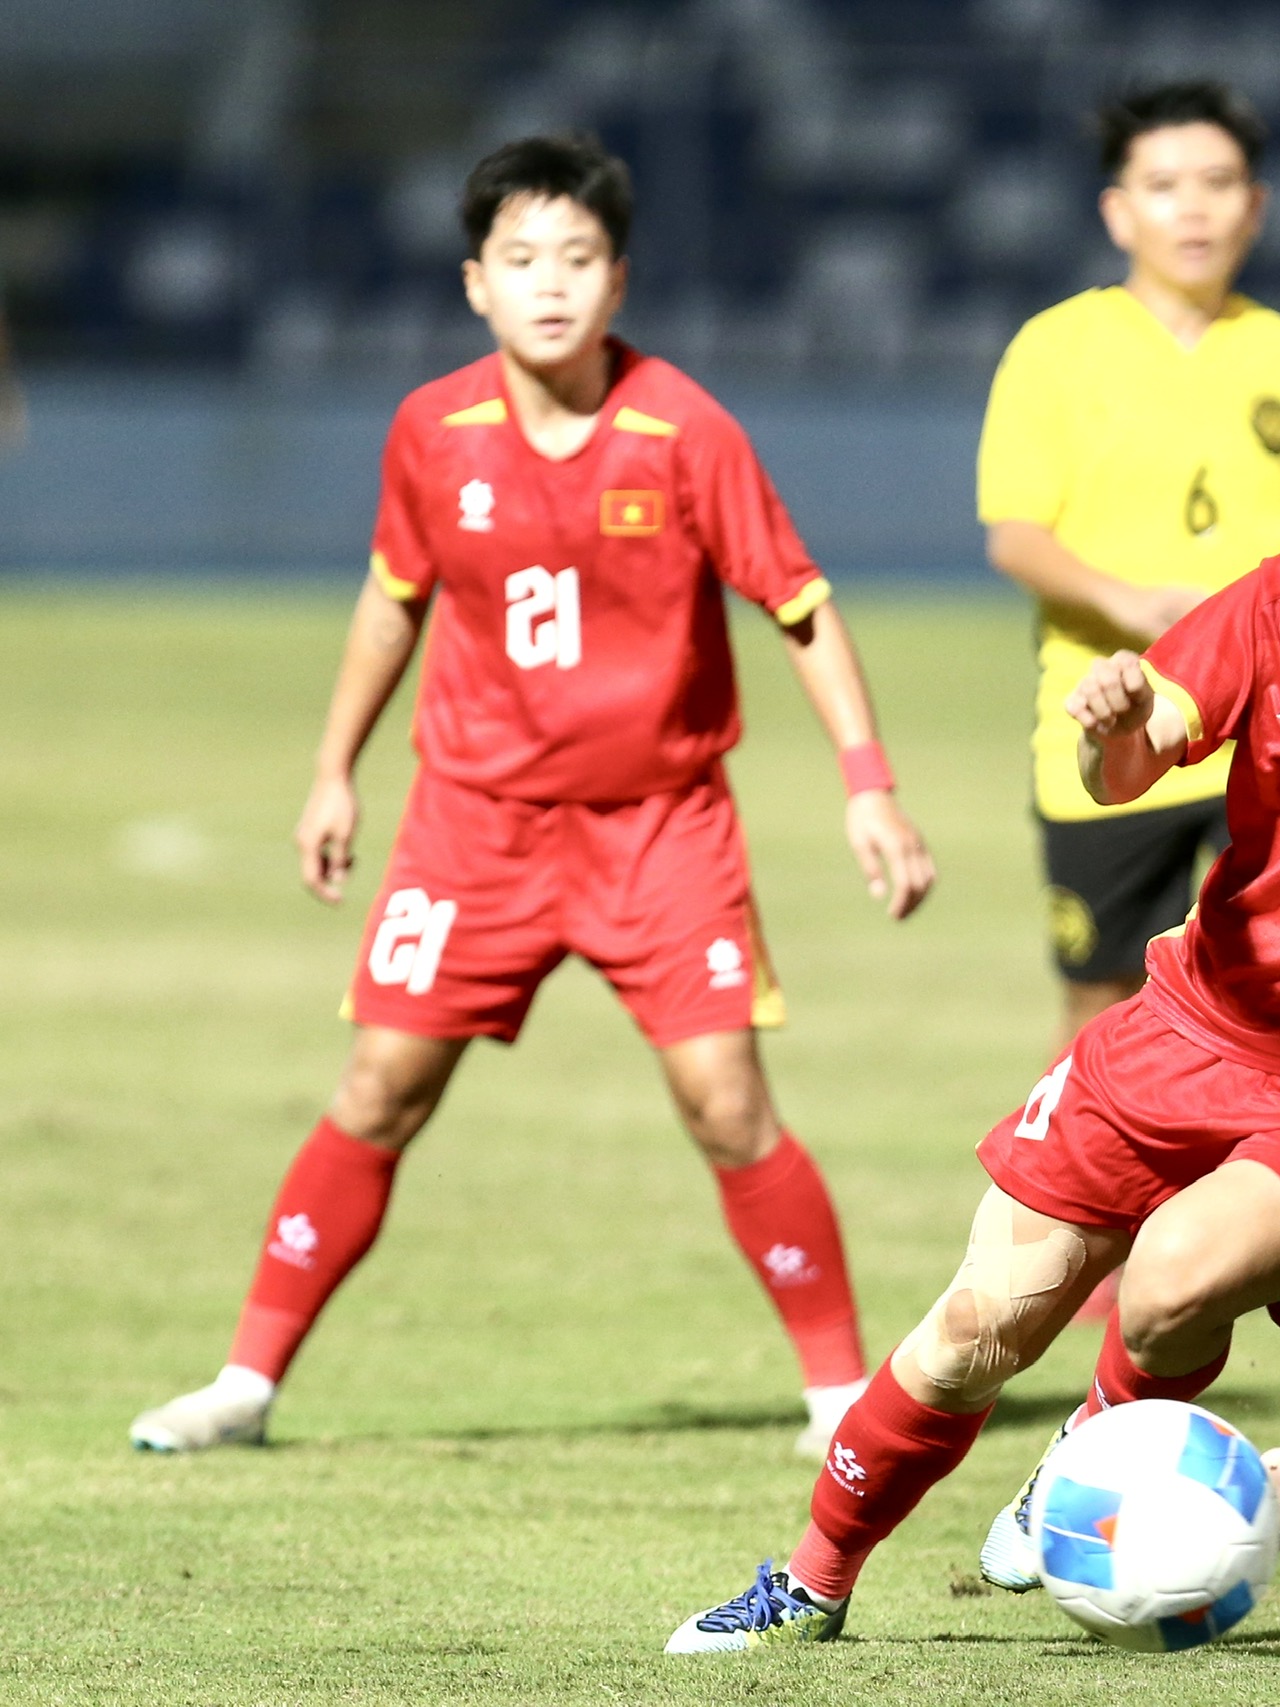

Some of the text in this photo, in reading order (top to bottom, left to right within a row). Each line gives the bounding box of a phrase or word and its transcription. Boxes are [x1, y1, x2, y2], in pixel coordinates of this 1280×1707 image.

[1186, 466, 1218, 537] 6
[504, 563, 582, 671] 21
[367, 886, 459, 996] 21
